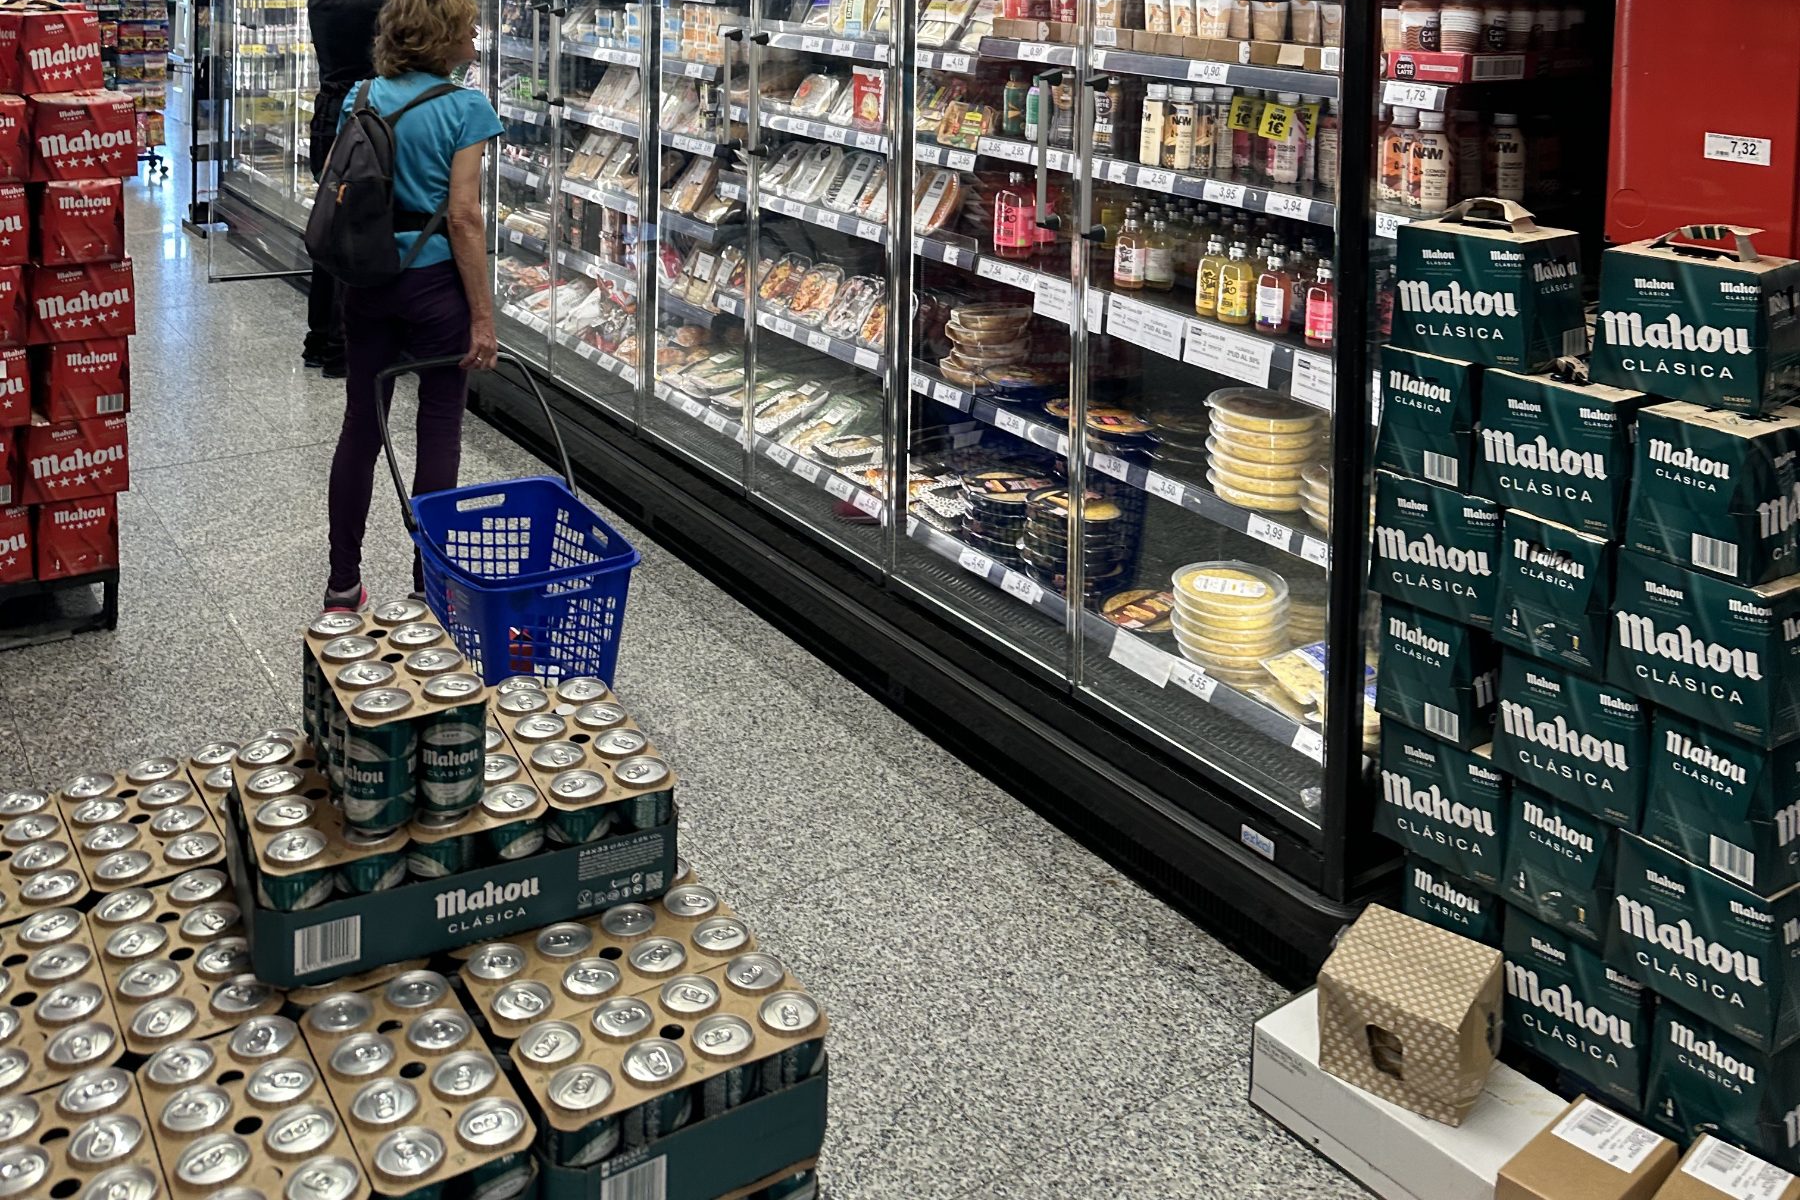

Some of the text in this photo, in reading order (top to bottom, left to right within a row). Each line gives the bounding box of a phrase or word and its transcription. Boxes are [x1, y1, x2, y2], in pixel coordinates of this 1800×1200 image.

[29, 42, 100, 71] Mahou
[1203, 66, 1220, 77] 0,90
[1405, 89, 1426, 103] 1,79
[59, 109, 85, 118] Mahou
[1235, 112, 1251, 124] 1€
[1267, 121, 1284, 134] 1€
[38, 129, 133, 158] Mahou
[1731, 141, 1757, 156] 7,32
[1151, 173, 1167, 184] 2,50
[59, 195, 111, 209] Mahou
[1218, 189, 1236, 200] 3,95
[1283, 199, 1300, 211] 3,94
[1378, 217, 1398, 231] 3,99
[1422, 249, 1455, 260] Mahou
[1634, 278, 1675, 290] Mahou
[36, 287, 130, 320] Mahou
[1397, 280, 1520, 317] Mahou
[1415, 323, 1504, 340] CLÁSICA
[1601, 310, 1752, 355] Mahou
[66, 352, 118, 366] Mahou
[1622, 359, 1734, 379] CLÁSICA
[1389, 370, 1451, 403] Mahou
[1394, 396, 1442, 414] CLÁSICA
[1508, 399, 1542, 413] Mahou
[30, 444, 125, 479] Mahou
[1106, 460, 1121, 473] 3,90
[1482, 428, 1608, 481] Mahou
[1649, 438, 1730, 480] Mahou
[1160, 481, 1176, 495] 3,50
[1500, 476, 1593, 503] CLÁSICA
[1655, 468, 1717, 492] CLÁSICA
[54, 507, 106, 524] Mahou
[1397, 498, 1428, 512] Mahou
[1265, 524, 1283, 539] 3,99
[1376, 525, 1492, 577] Mahou
[1391, 570, 1477, 598] CLÁSICA
[1520, 566, 1575, 591] CLÁSICA
[1645, 580, 1684, 599] Mahou
[1389, 616, 1450, 658] Mahou
[1616, 610, 1763, 681] Mahou
[1394, 643, 1441, 668] CLÁSICA
[1188, 673, 1206, 690] 4,55
[1526, 672, 1560, 692] Mahou
[1635, 665, 1743, 705] CLÁSICA
[1500, 699, 1629, 772] Mahou
[422, 748, 479, 767] Mahou
[1403, 744, 1436, 763] Mahou
[1666, 730, 1747, 785] Mahou
[344, 766, 384, 784] ahou
[1518, 750, 1614, 793] CLÁSICA
[1672, 761, 1734, 796] CLÁSICA
[1381, 769, 1496, 837] Mahou
[1397, 817, 1483, 856] CLÁSICA
[1523, 800, 1594, 853] Mahou
[1529, 830, 1583, 863] CLÁSICA
[1414, 867, 1481, 915] Mahou
[1646, 869, 1686, 894] Mahou
[435, 877, 541, 919] Mahou
[1419, 896, 1470, 925] CLÁSICA
[1531, 936, 1566, 961] Mahou
[1616, 894, 1764, 987] Mahou
[1635, 951, 1745, 1009] CLÁSICA
[1504, 960, 1636, 1049] Mahou
[1521, 1013, 1619, 1069] CLÁSICA
[1670, 1020, 1756, 1085] Mahou
[1677, 1054, 1743, 1095] CLÁSICA
